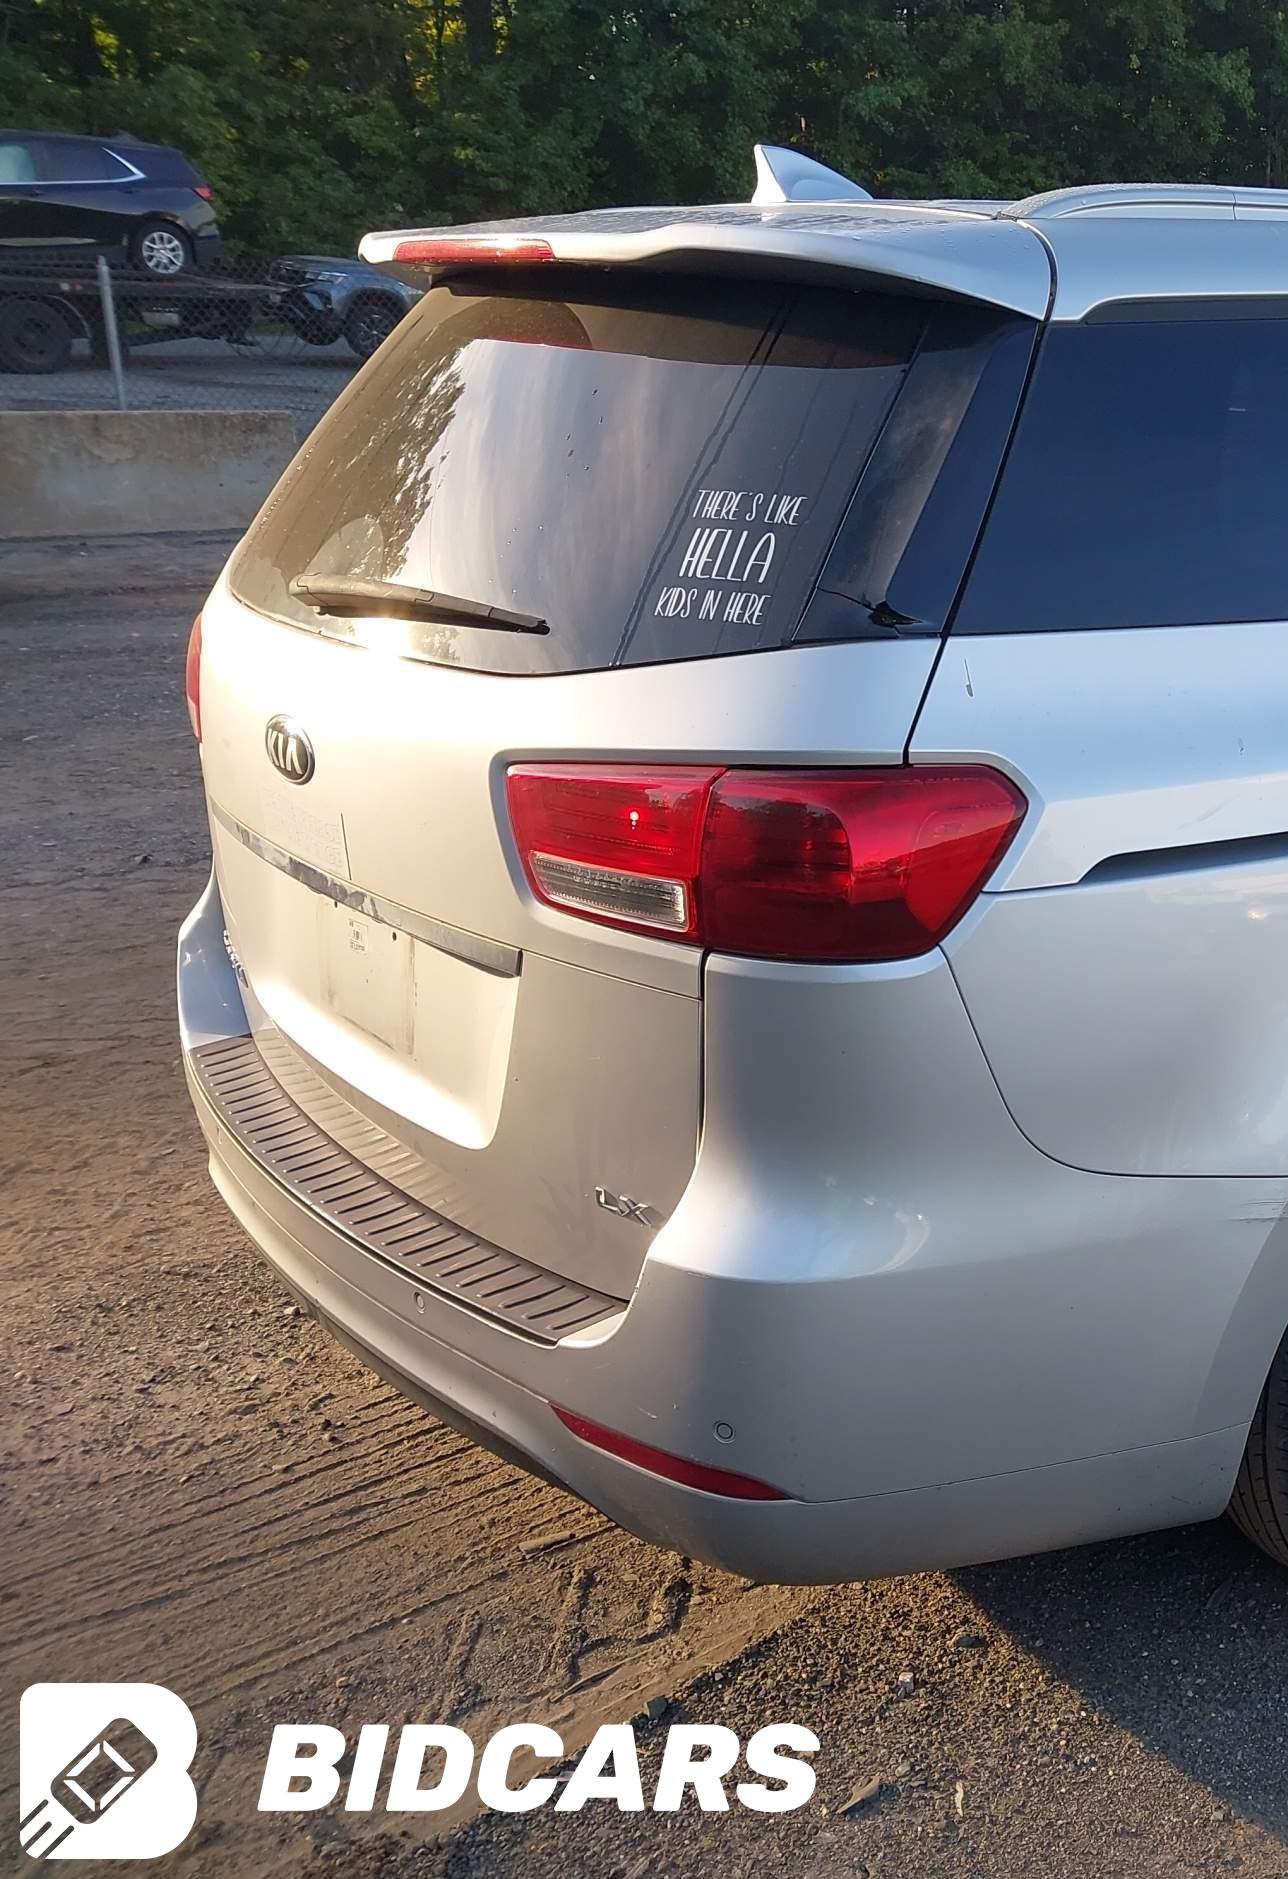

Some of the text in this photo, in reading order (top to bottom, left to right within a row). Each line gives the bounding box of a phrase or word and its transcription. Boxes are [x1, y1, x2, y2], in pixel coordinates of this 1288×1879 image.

[692, 489, 808, 526] THERE'S LIKE
[678, 527, 776, 584] HELLA
[654, 586, 771, 626] KIDS IN HERE
[594, 1185, 650, 1226] LX
